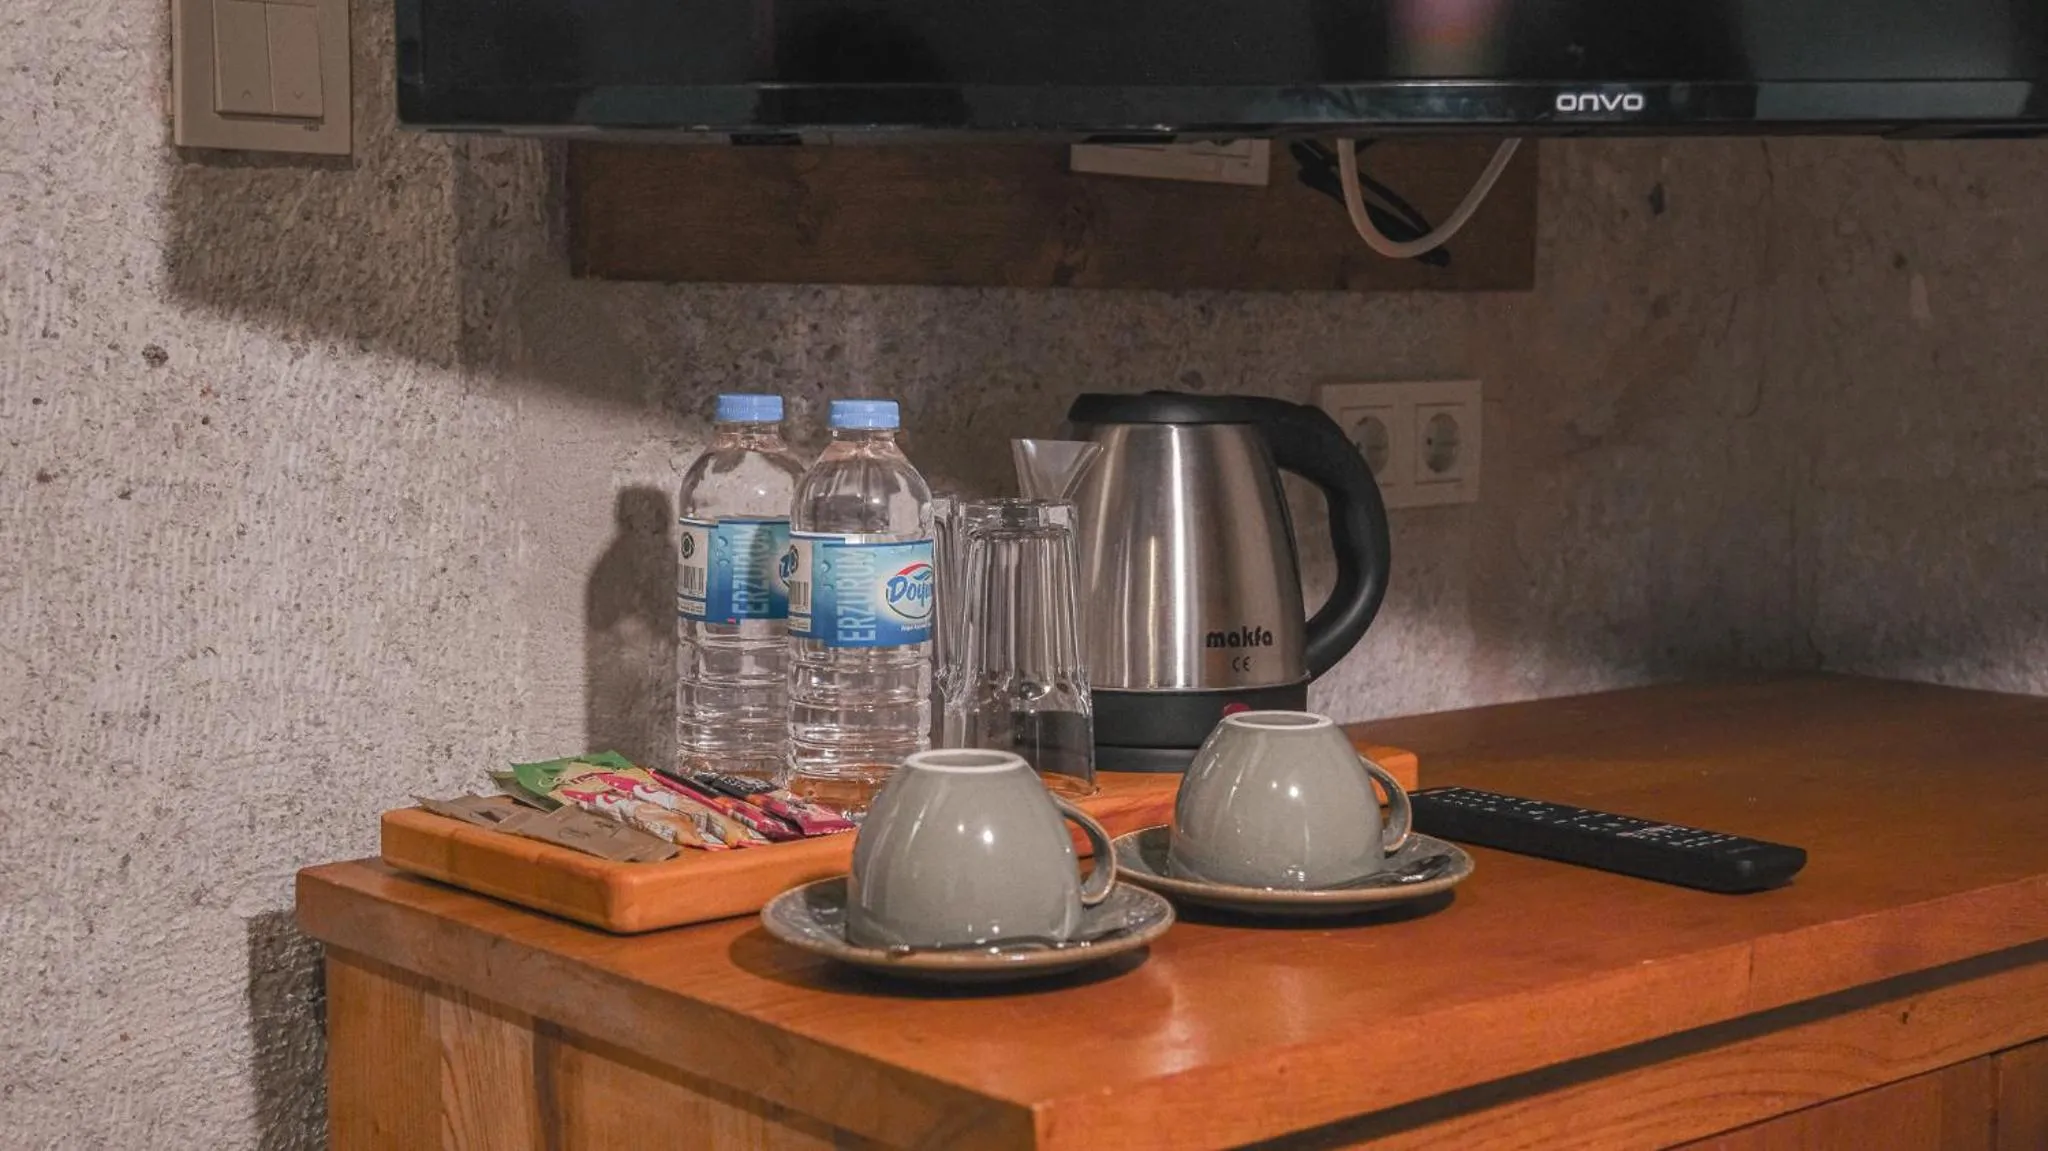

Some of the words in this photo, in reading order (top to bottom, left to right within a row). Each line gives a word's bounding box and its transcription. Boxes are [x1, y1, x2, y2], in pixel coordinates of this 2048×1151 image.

[836, 548, 876, 641] ERZURUM
[1206, 625, 1273, 648] makfa
[1232, 656, 1251, 672] CE
